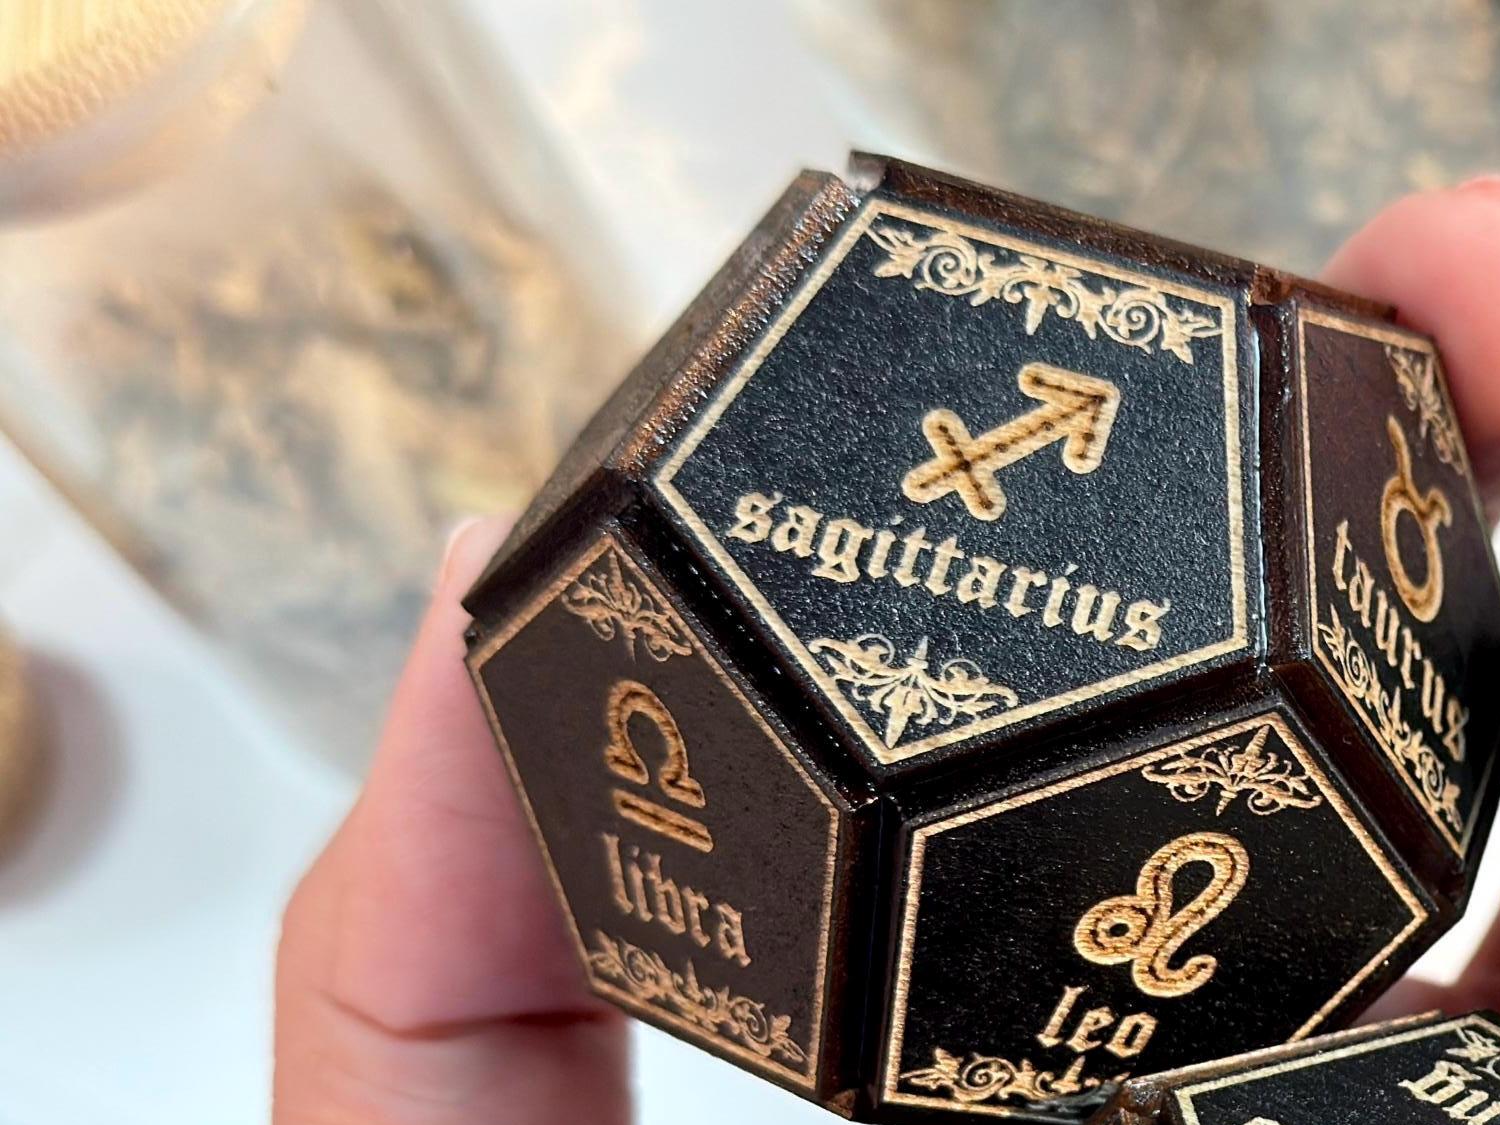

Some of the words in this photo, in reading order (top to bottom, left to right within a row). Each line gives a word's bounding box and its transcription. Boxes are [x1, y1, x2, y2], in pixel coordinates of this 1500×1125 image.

[726, 490, 1172, 653] sagittarius
[1332, 519, 1470, 763] taurus
[600, 834, 752, 968] libra
[1035, 984, 1160, 1058] leo
